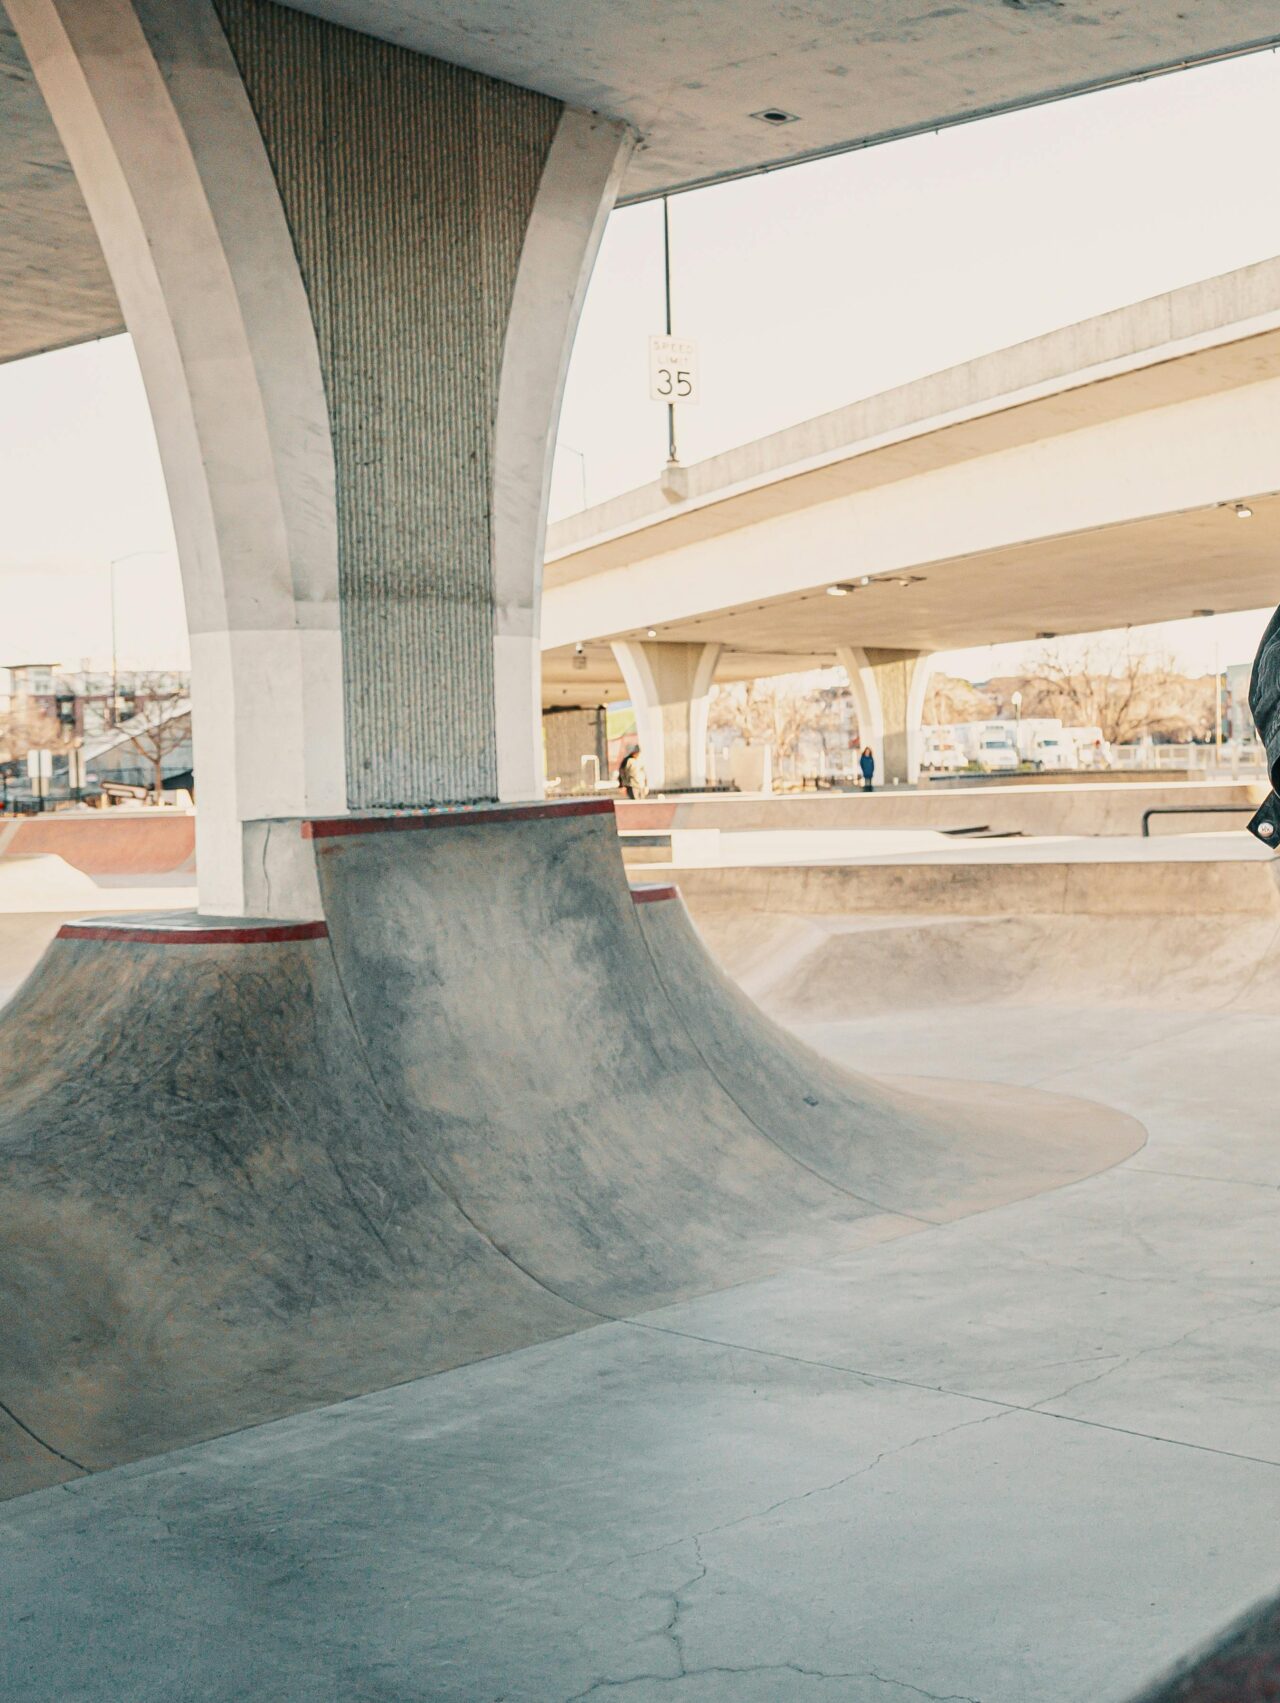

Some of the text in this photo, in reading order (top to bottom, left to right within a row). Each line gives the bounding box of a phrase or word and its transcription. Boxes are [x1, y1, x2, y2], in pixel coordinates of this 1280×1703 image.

[653, 341, 693, 354] SPEED
[657, 354, 689, 367] LIMIT
[656, 368, 693, 397] 35
